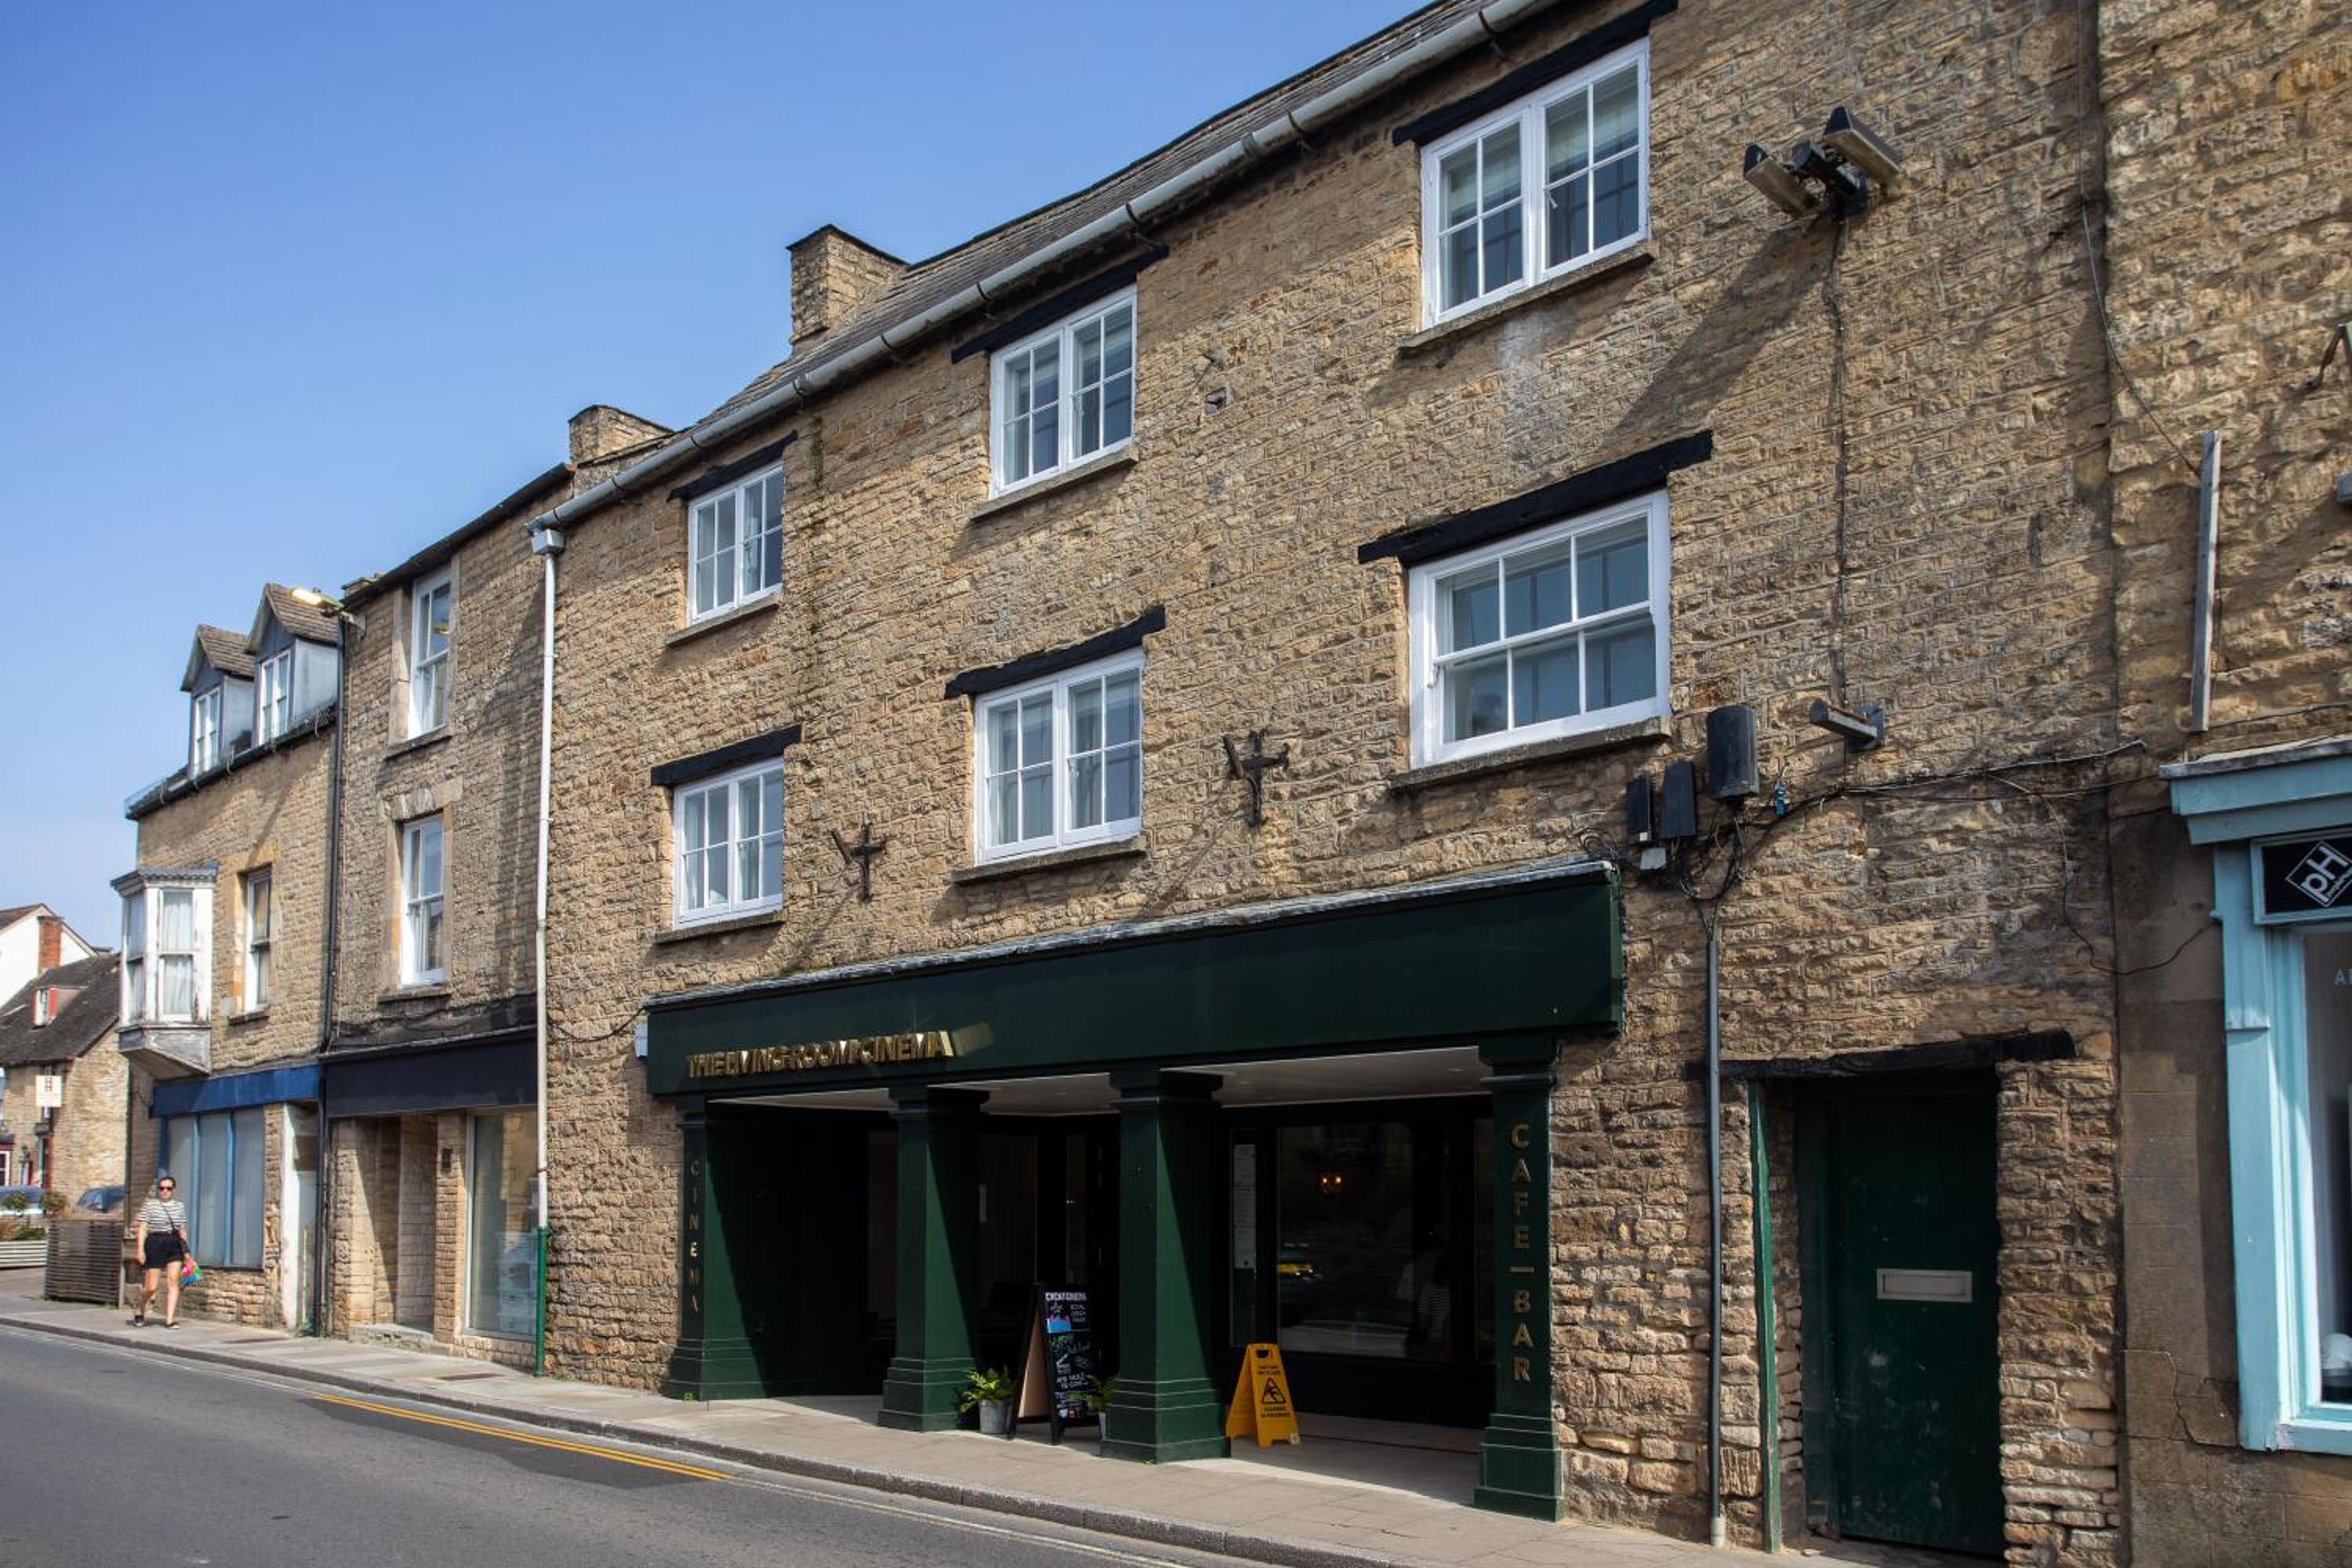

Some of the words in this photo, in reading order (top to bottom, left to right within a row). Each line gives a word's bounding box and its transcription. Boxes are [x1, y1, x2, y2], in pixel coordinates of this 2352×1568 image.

[689, 1051, 726, 1078] THE
[726, 1045, 790, 1075] LIVING
[790, 1039, 860, 1070] ROOM
[861, 1030, 953, 1064] CINEMA
[689, 1160, 700, 1314] CINEMA
